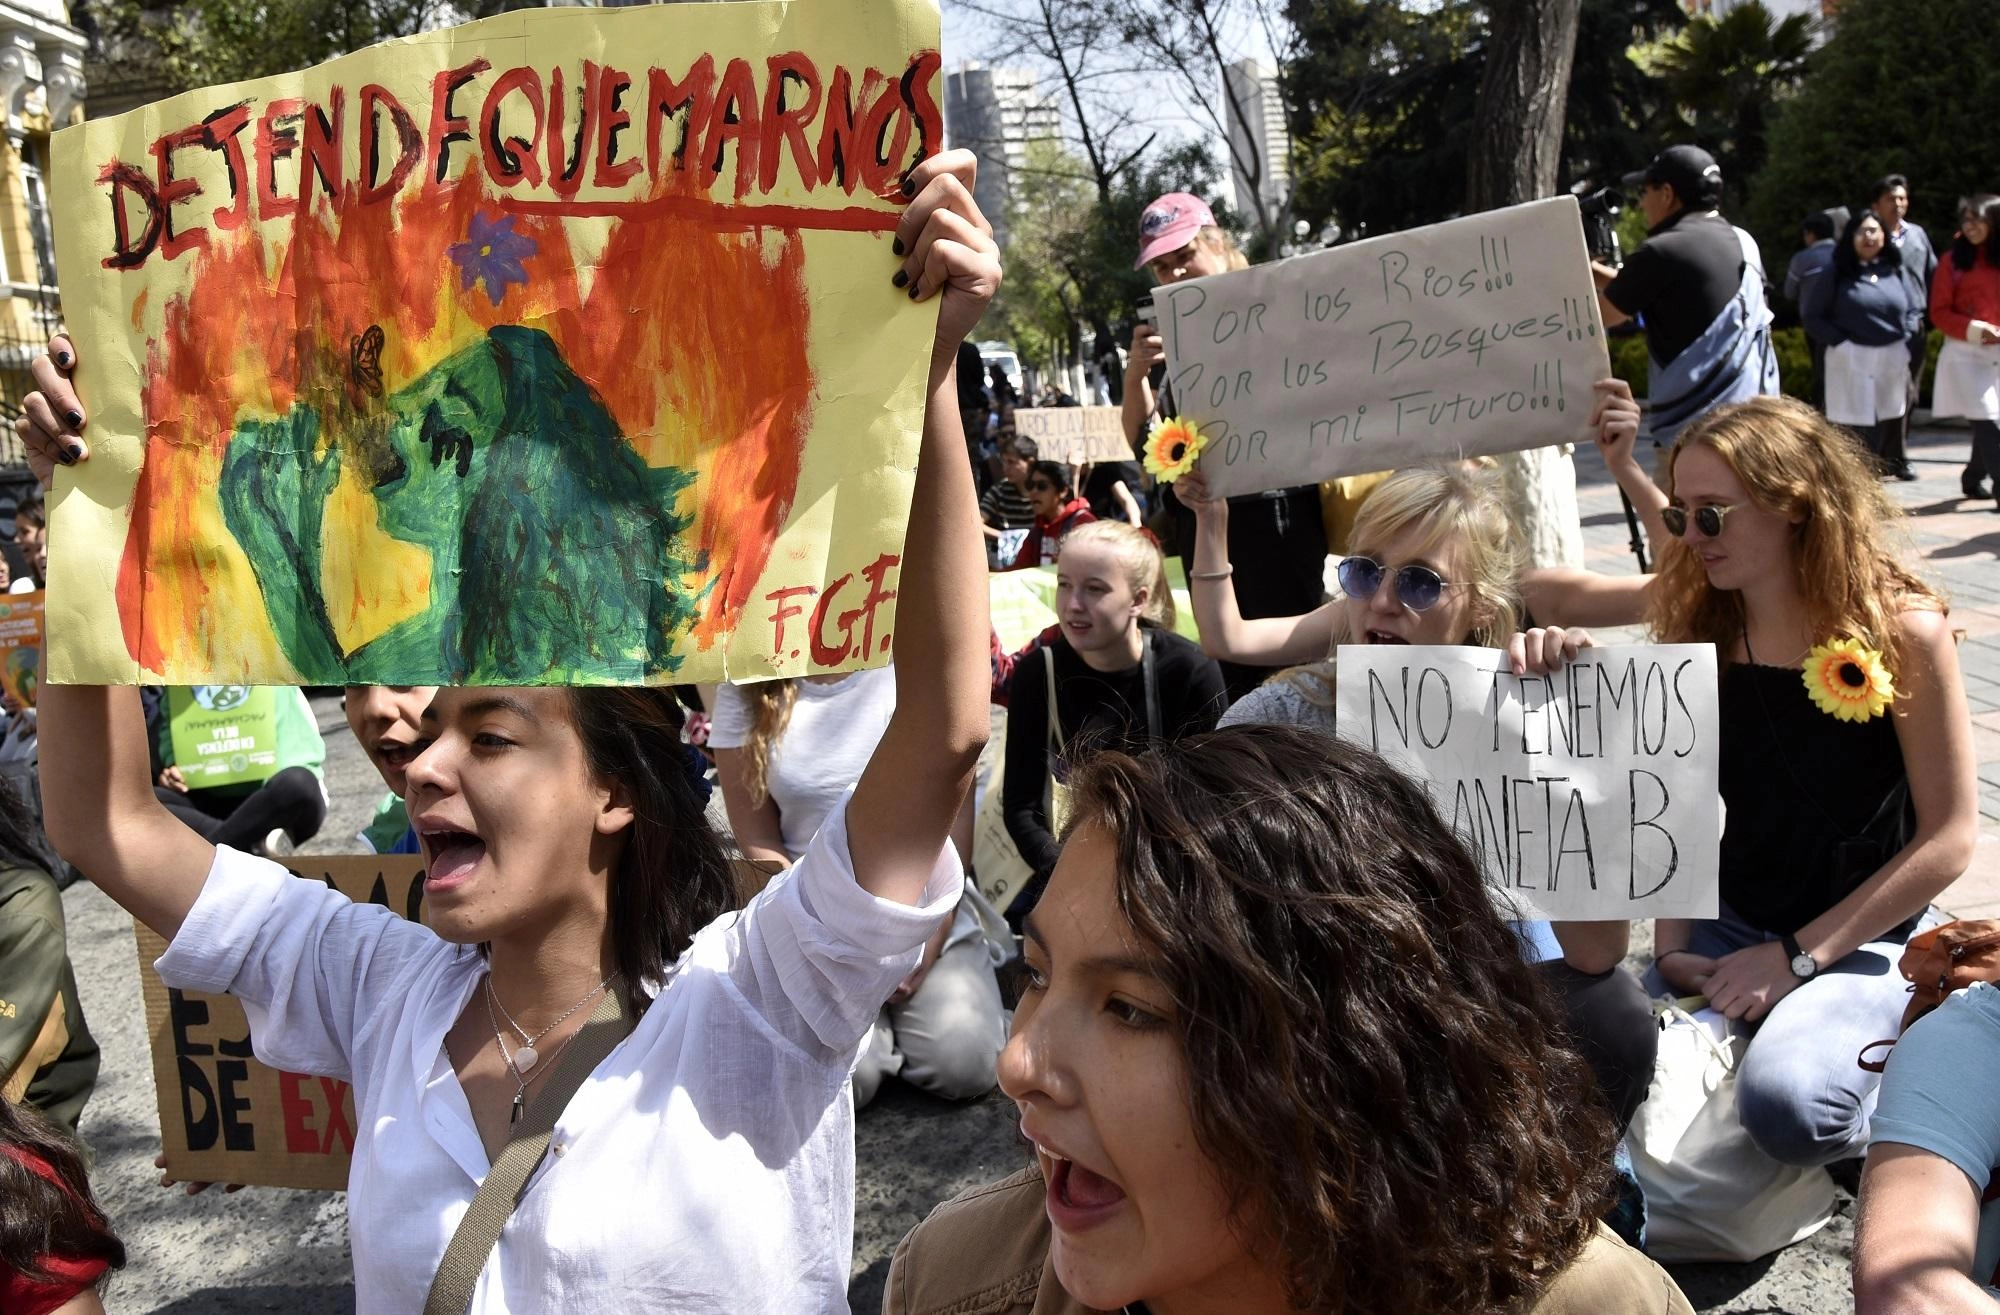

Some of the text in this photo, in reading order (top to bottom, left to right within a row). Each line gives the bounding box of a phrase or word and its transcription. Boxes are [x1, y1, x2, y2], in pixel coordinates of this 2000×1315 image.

[95, 84, 345, 271] DEJEN
[479, 48, 942, 204] QUEMARNOS
[1304, 286, 1351, 323] los
[1283, 359, 1329, 390] los
[1367, 656, 1696, 760] NO TENEMOS
[1627, 768, 1680, 901] B
[176, 1055, 256, 1152] DE
